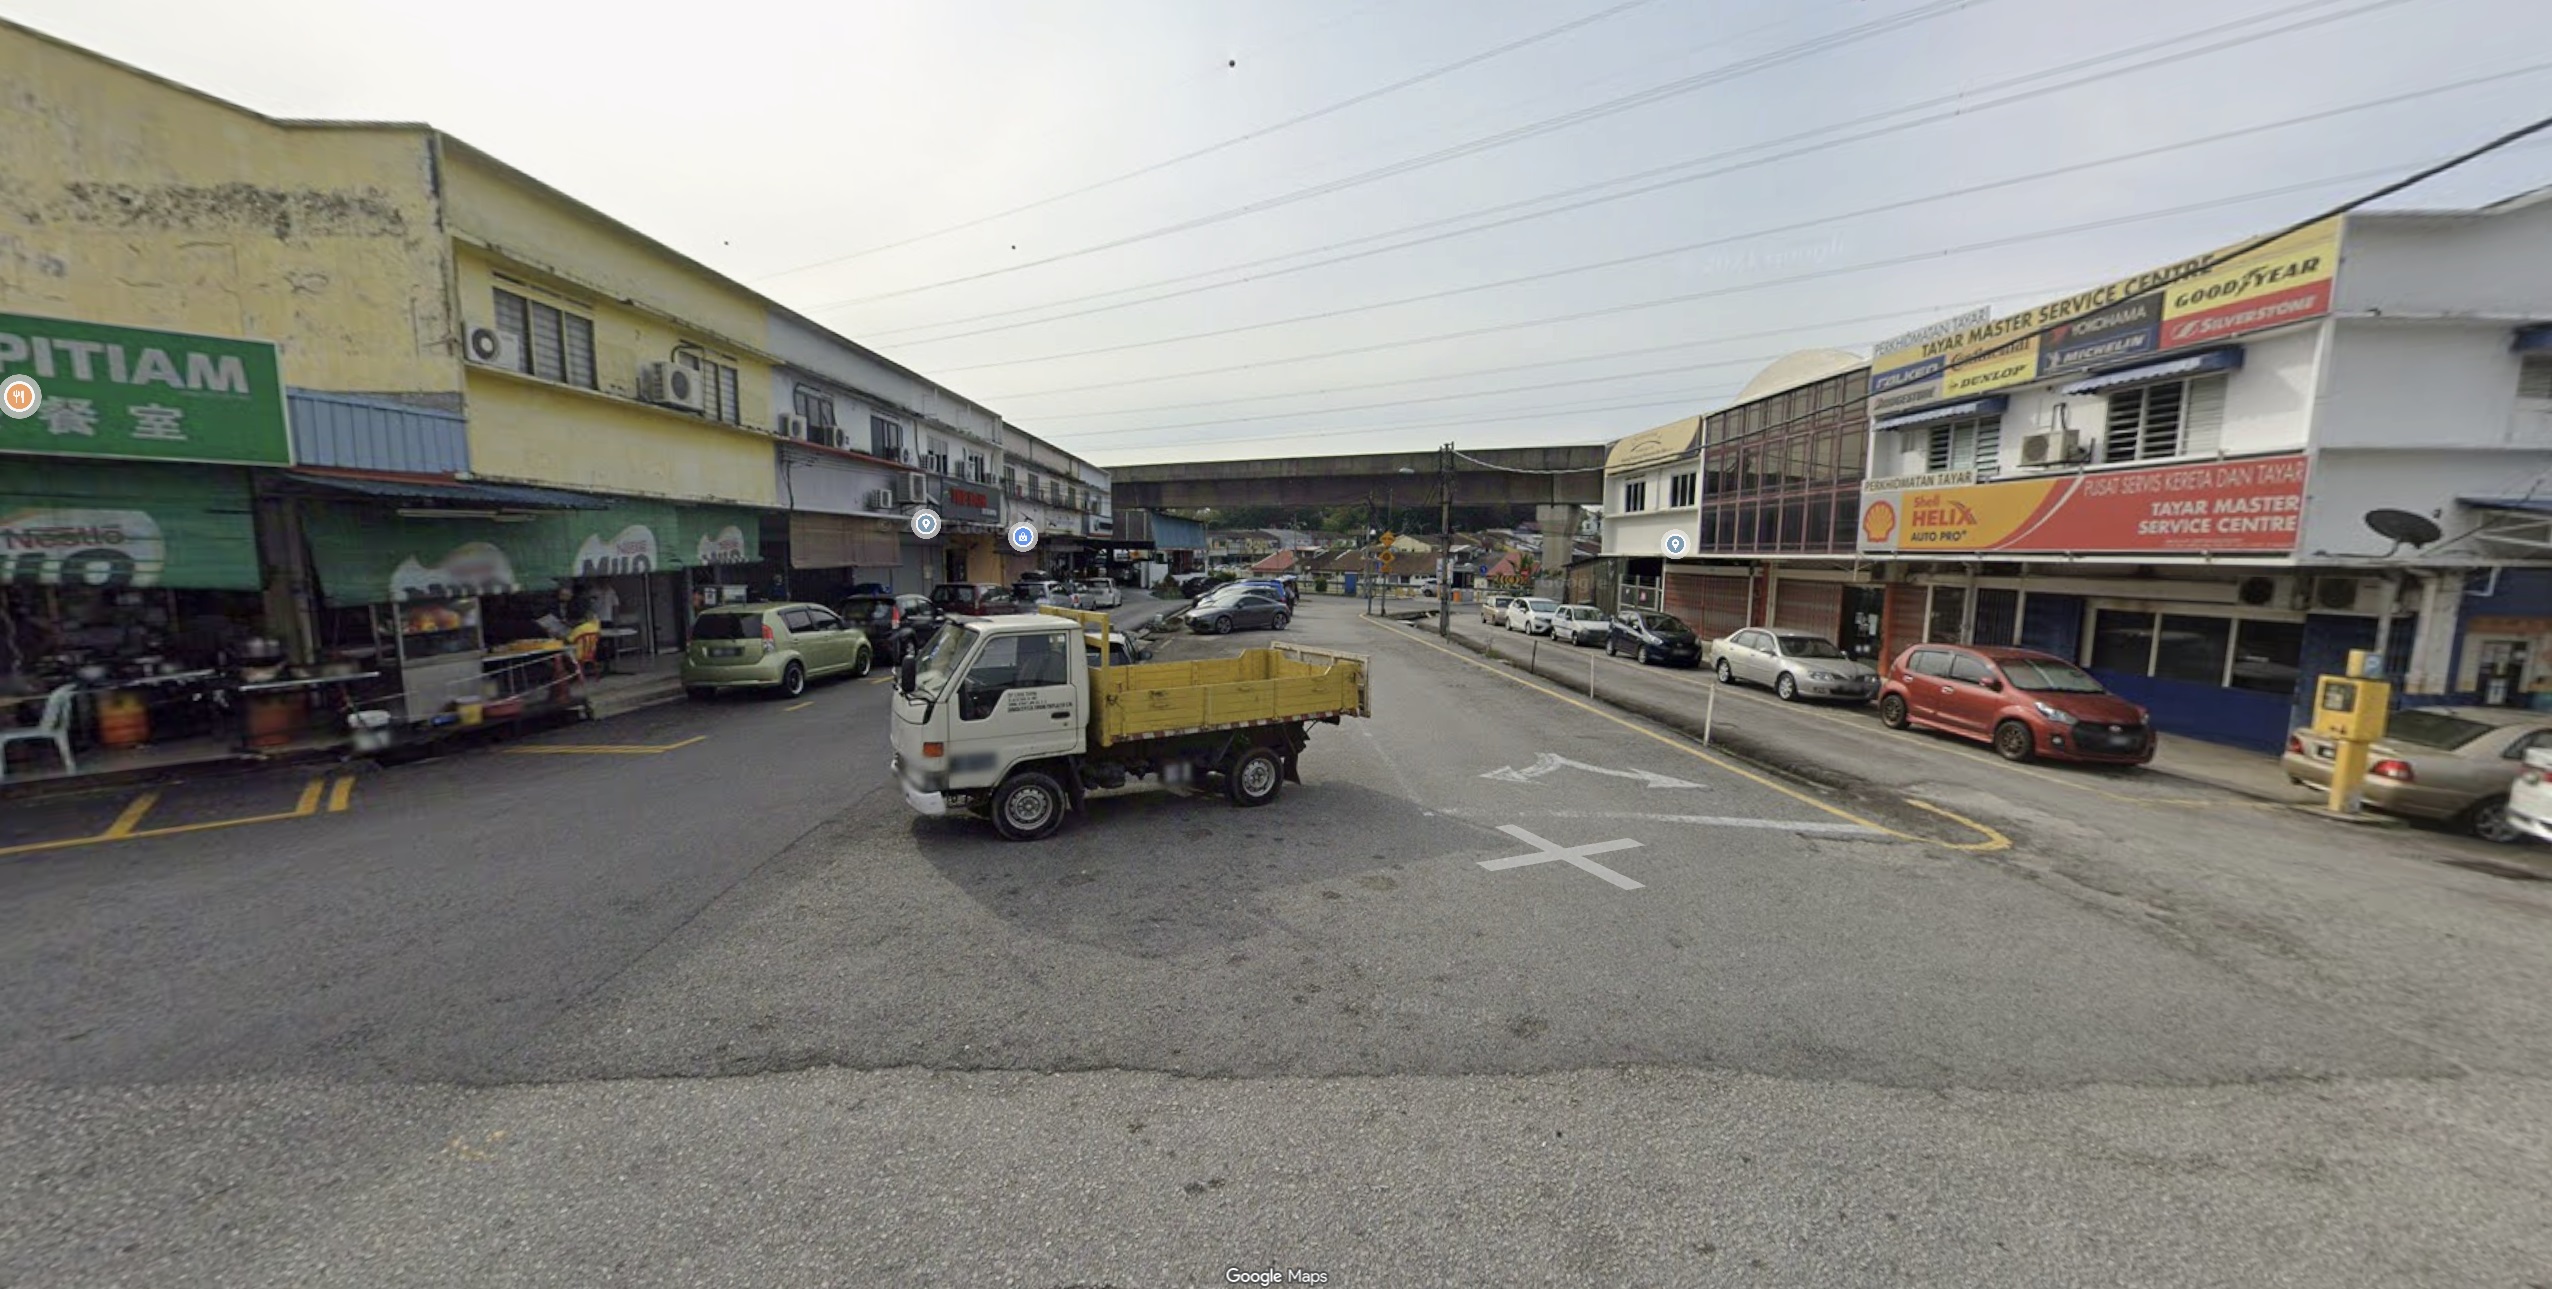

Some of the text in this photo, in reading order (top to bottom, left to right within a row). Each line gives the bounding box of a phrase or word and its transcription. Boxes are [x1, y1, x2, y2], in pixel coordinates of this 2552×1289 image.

[1922, 254, 2214, 358] TAYAR MASTER SERVICE CENTRE
[1960, 364, 2028, 389] DUNLOP
[1865, 471, 1973, 493] PERKHIDMATAN TAYAR
[2084, 461, 2305, 497] PUSAT SERVIS KERETA DAN TAYAR
[1914, 494, 1940, 508] Shell
[2151, 495, 2300, 517] TAYAR MASTER
[1912, 502, 1978, 527] HELIX
[2136, 515, 2298, 536] SERVICE CENTRE
[1911, 531, 1937, 542] AUTO
